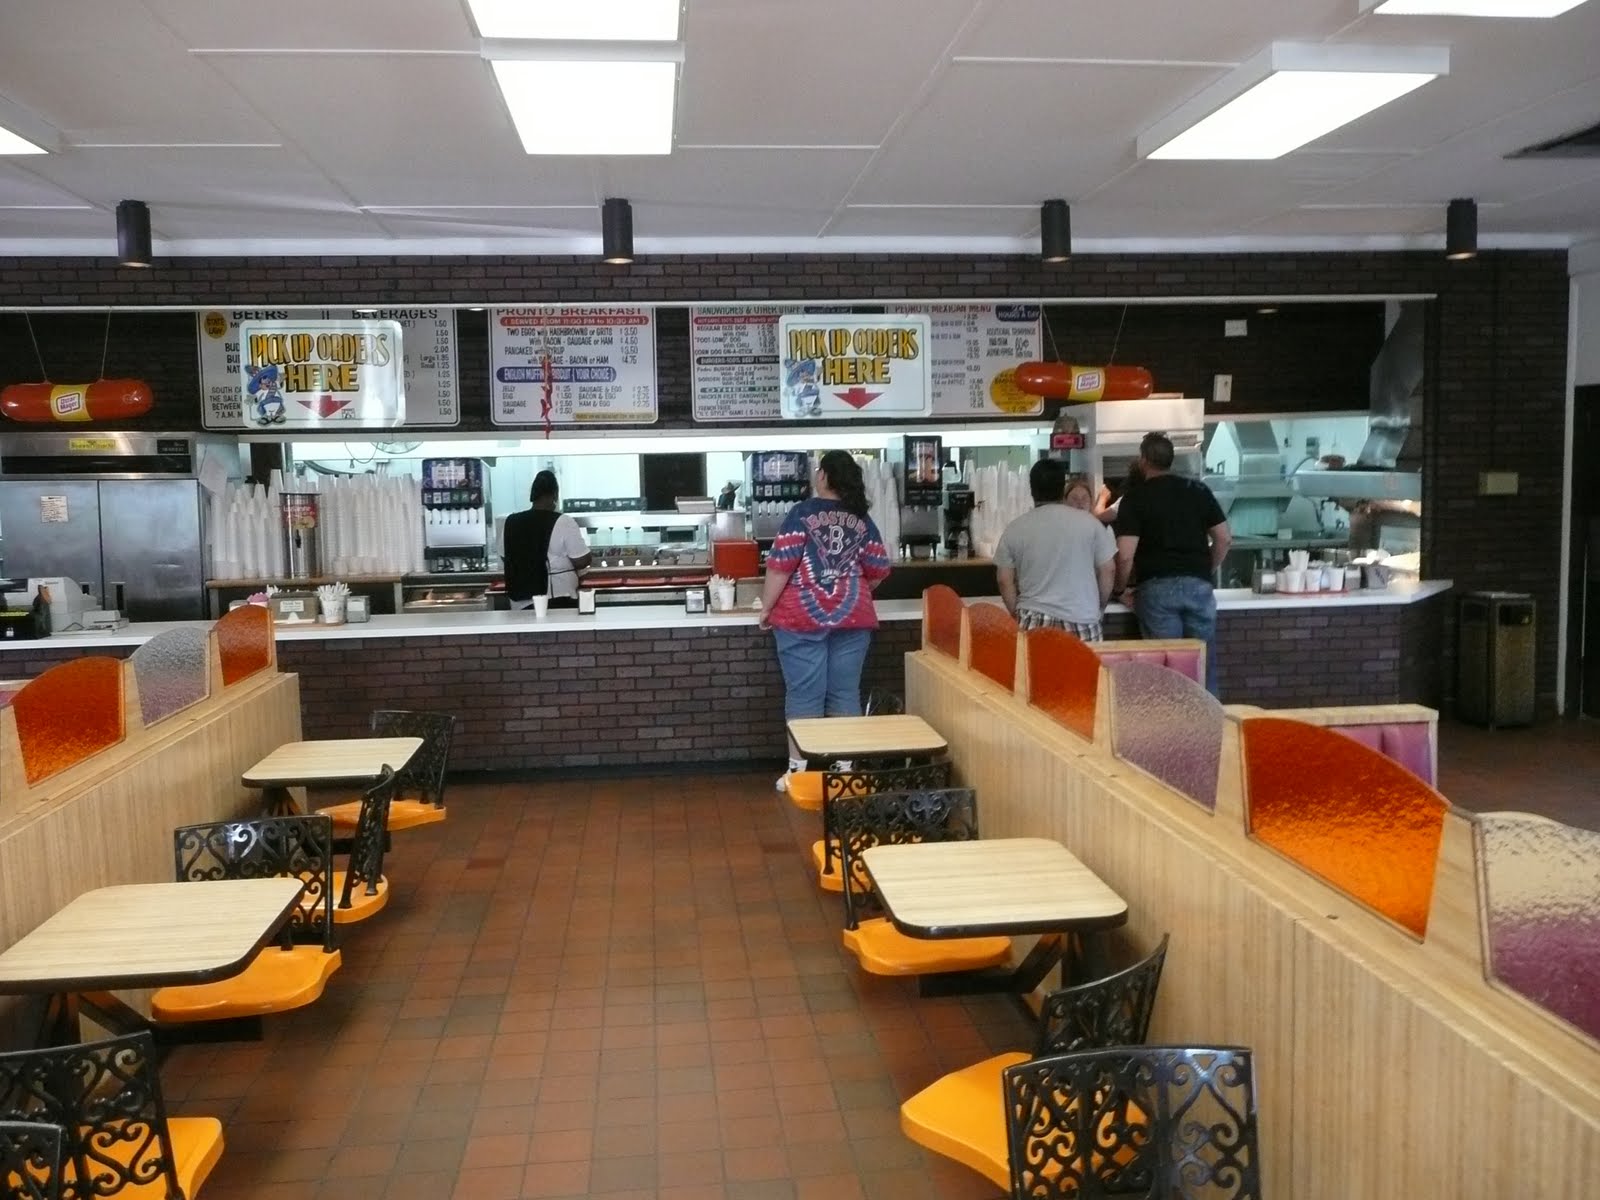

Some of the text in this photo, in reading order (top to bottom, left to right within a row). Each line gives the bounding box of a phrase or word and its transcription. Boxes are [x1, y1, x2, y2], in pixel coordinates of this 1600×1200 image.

[233, 310, 288, 320] BEERS
[352, 308, 438, 320] BEVERAGES
[496, 307, 641, 316] PRONTO BREAKFAST
[543, 336, 562, 346] ACON
[788, 328, 920, 362] PICK UP ORDERS
[249, 333, 391, 368] PICK UP ORDERS
[538, 355, 564, 365] SAAGE
[226, 365, 241, 374] NAT
[822, 357, 892, 386] HERE
[283, 363, 360, 393] HERE
[806, 510, 868, 535] BOSTON
